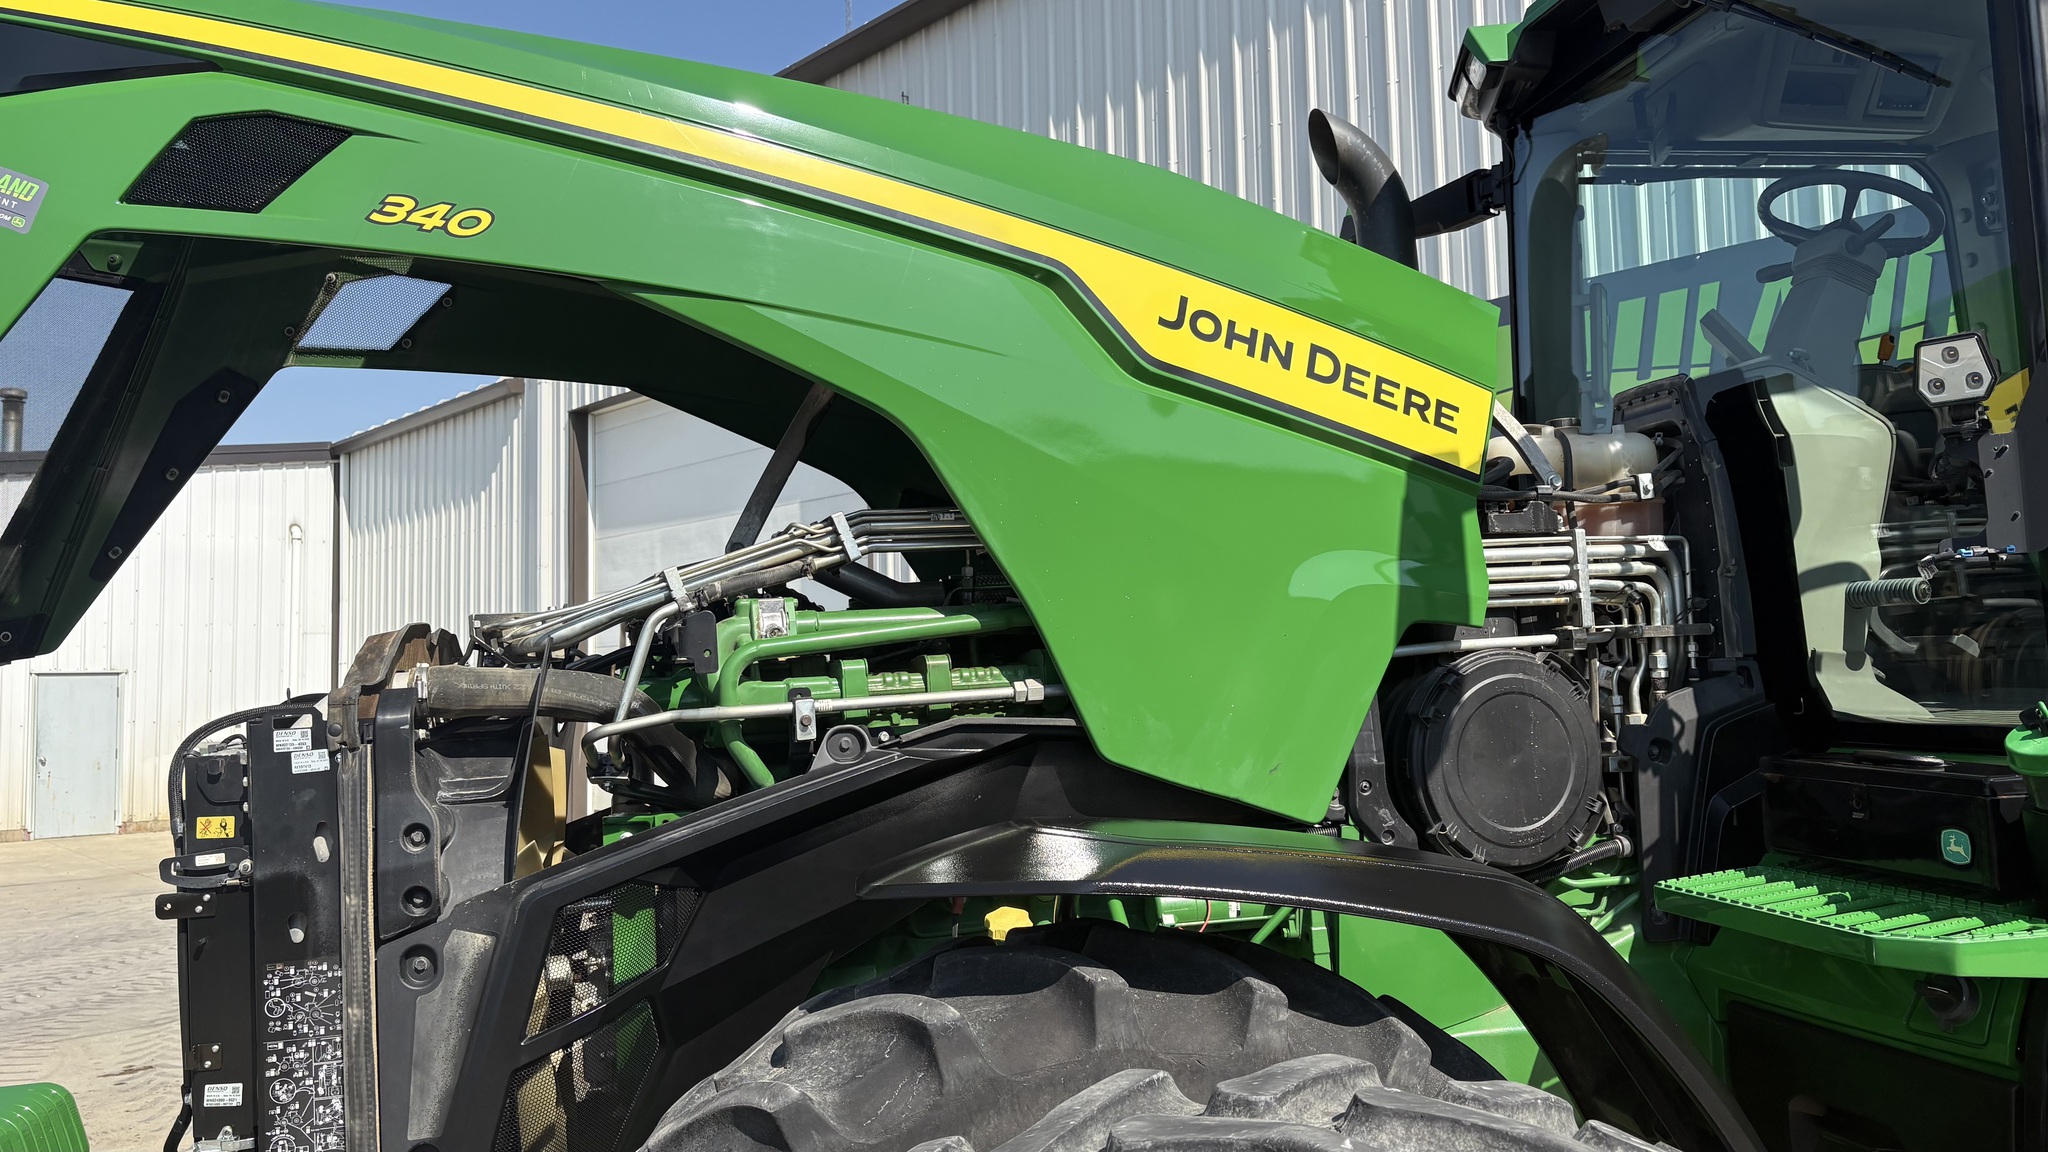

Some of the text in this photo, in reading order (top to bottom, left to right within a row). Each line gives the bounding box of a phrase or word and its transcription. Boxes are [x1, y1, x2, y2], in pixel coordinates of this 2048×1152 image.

[0, 173, 40, 202] AND
[0, 196, 18, 209] NT
[365, 194, 495, 238] 340
[1157, 295, 1460, 435] JOHN DEERE
